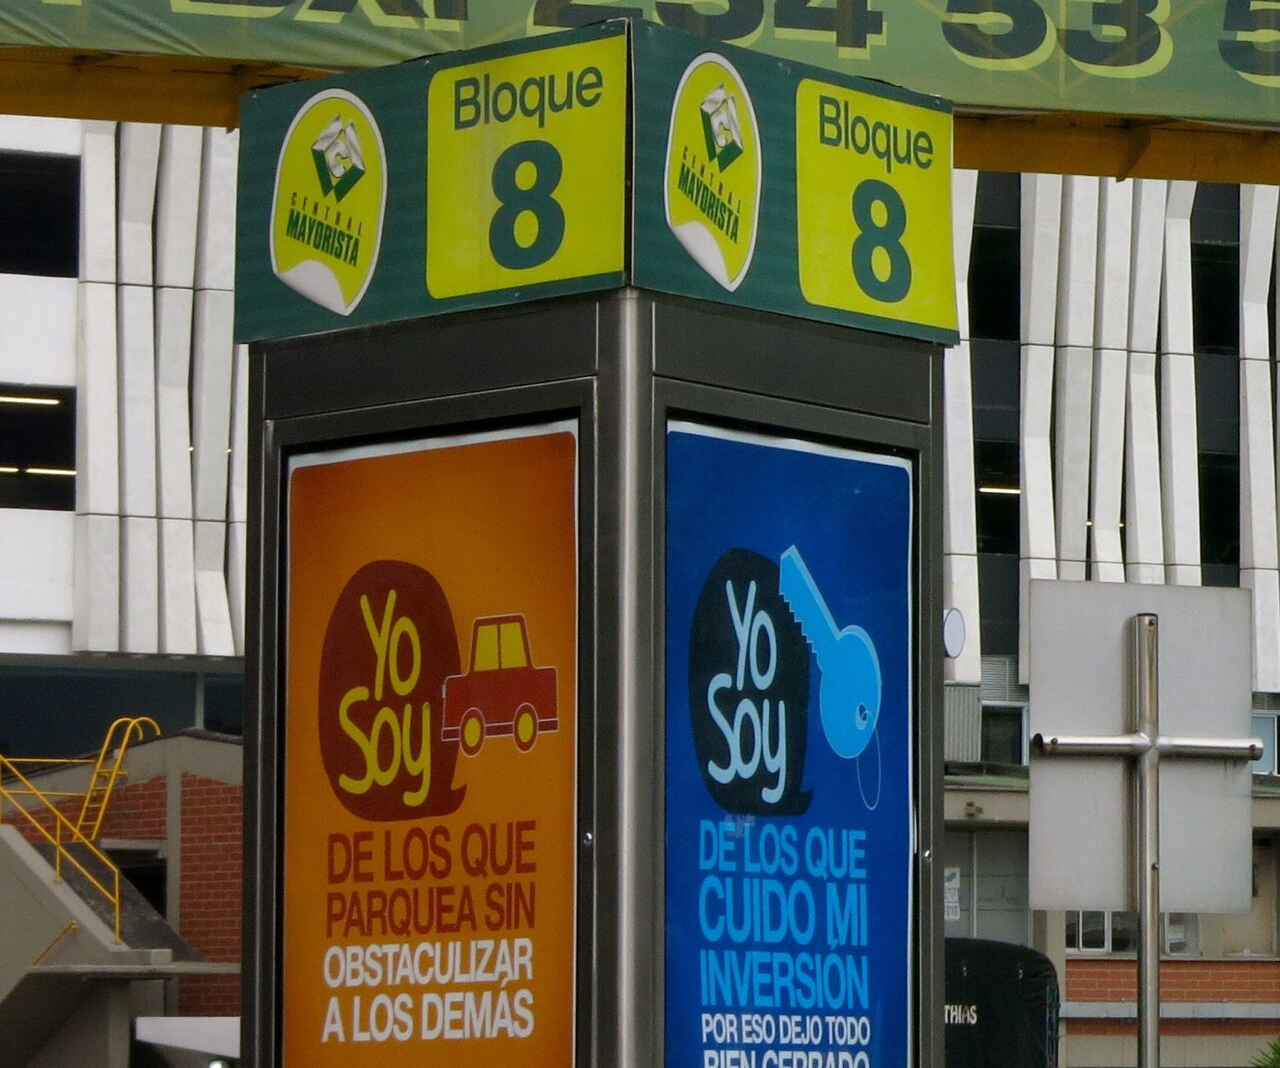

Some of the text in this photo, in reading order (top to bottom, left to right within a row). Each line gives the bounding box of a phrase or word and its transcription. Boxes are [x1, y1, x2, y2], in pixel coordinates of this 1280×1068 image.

[453, 66, 604, 131] Bloque
[818, 95, 934, 173] Bloque
[489, 139, 565, 270] 8
[678, 162, 739, 244] MAYORISTA
[286, 208, 359, 267] MAYORISTA
[850, 179, 913, 304] 8
[327, 820, 537, 884] DE LOS QUE
[700, 820, 867, 880] DE LOS QUE
[326, 881, 536, 938] PARQUEA SIN
[698, 874, 816, 946] CUIDO
[826, 882, 867, 947] MI
[323, 937, 533, 988] OBSTACULIZAR
[700, 937, 869, 1009] INVERSIÓN
[321, 977, 535, 1043] A LOS DEMÁS
[701, 1013, 871, 1046] POR ESO DEJO TODO
